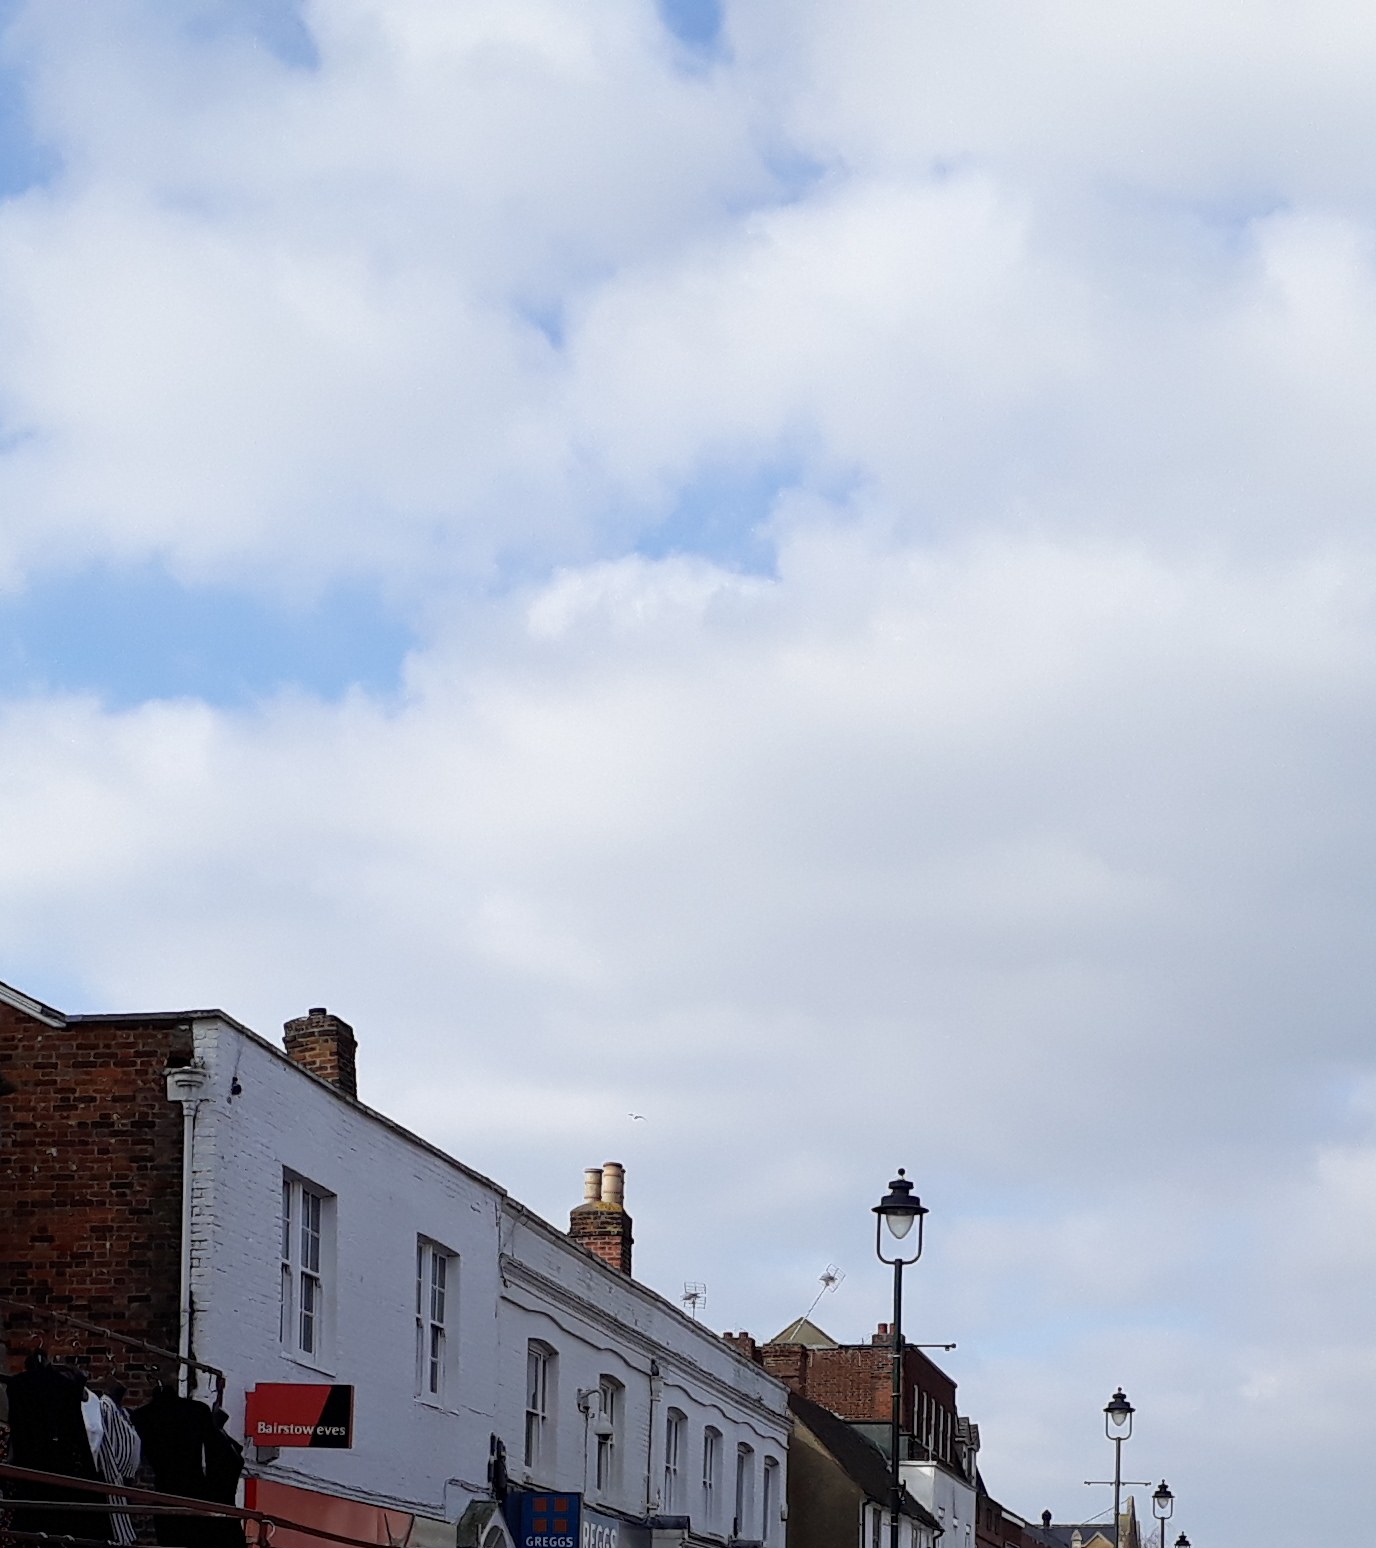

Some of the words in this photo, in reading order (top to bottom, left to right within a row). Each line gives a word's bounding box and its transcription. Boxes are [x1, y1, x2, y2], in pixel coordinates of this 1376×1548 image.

[257, 1421, 314, 1435] Bairstow
[316, 1426, 346, 1436] eves
[525, 1535, 574, 1548] GREGGS
